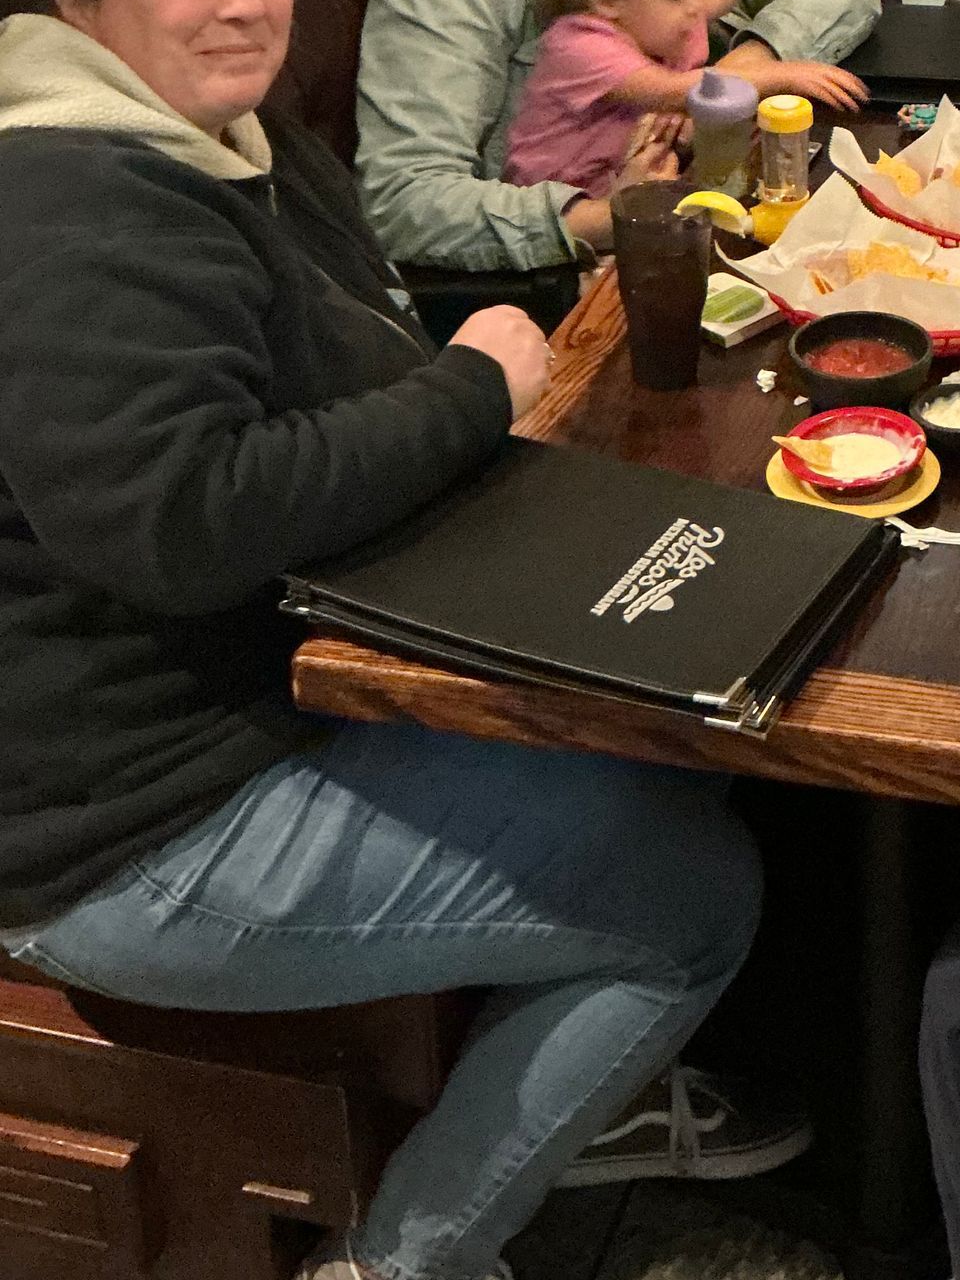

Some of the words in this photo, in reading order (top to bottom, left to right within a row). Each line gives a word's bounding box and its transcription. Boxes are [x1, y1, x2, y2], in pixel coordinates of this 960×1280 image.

[638, 523, 725, 586] Primos
[644, 518, 690, 558] MEXICAN
[673, 545, 716, 578] Los
[589, 557, 652, 616] RESTAURANT
